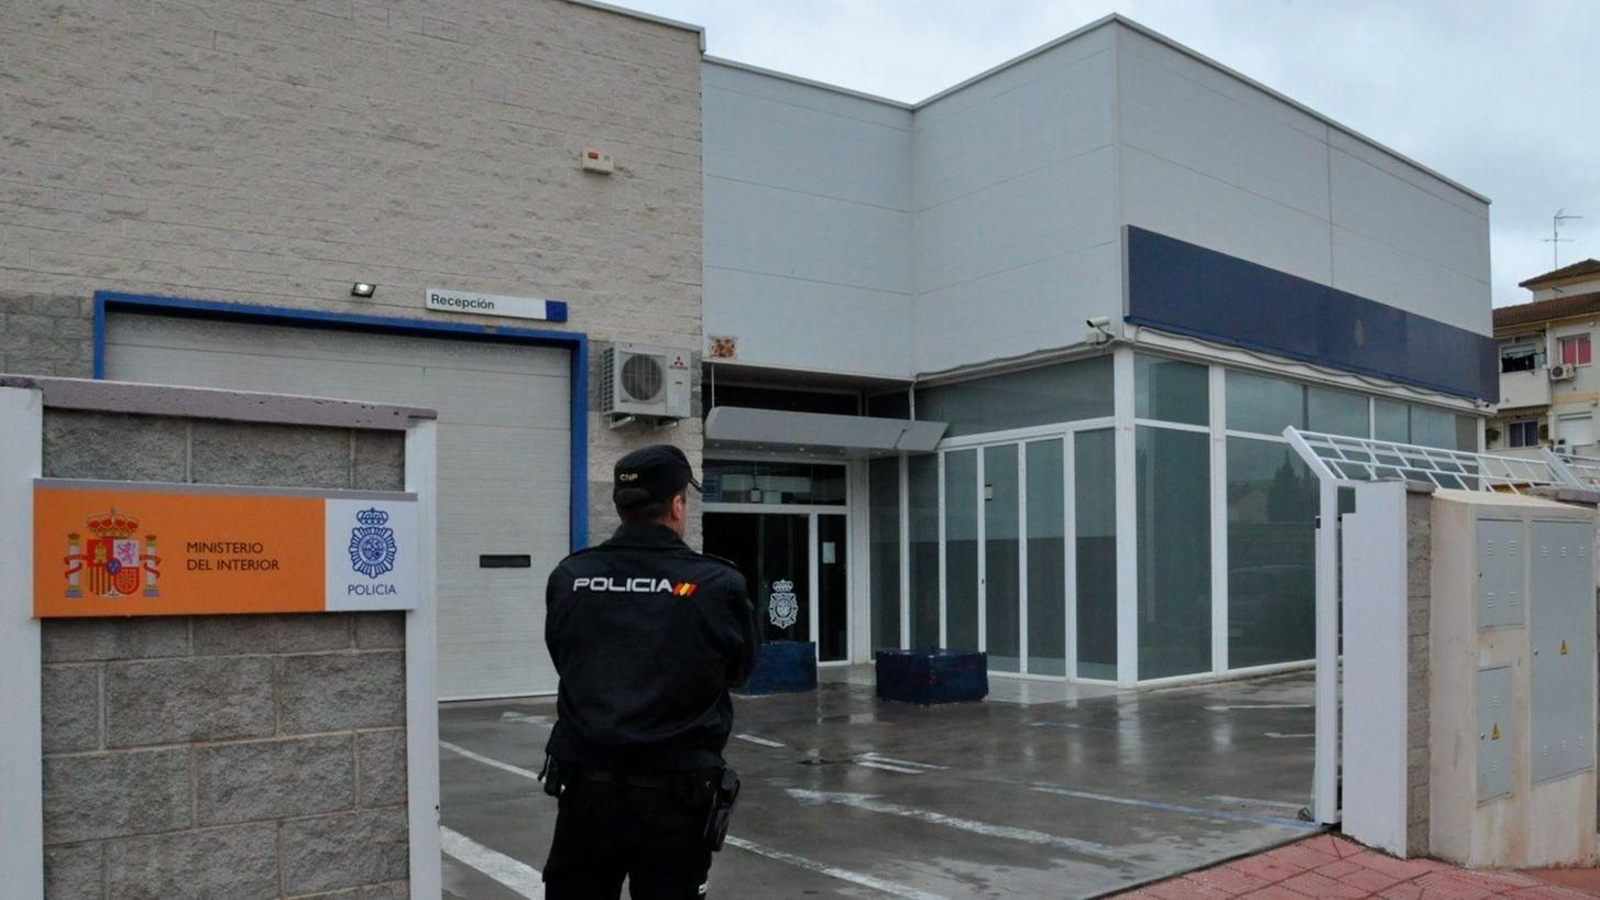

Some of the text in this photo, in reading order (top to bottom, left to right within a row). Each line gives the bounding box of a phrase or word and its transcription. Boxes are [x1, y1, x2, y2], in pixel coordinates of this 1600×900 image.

[431, 293, 495, 310] Recepción
[619, 473, 639, 482] CNP
[186, 541, 264, 555] MINISTERIO
[186, 558, 280, 572] DEL INTERIOR
[347, 583, 397, 596] POLICIA
[572, 577, 673, 593] POLICIA
